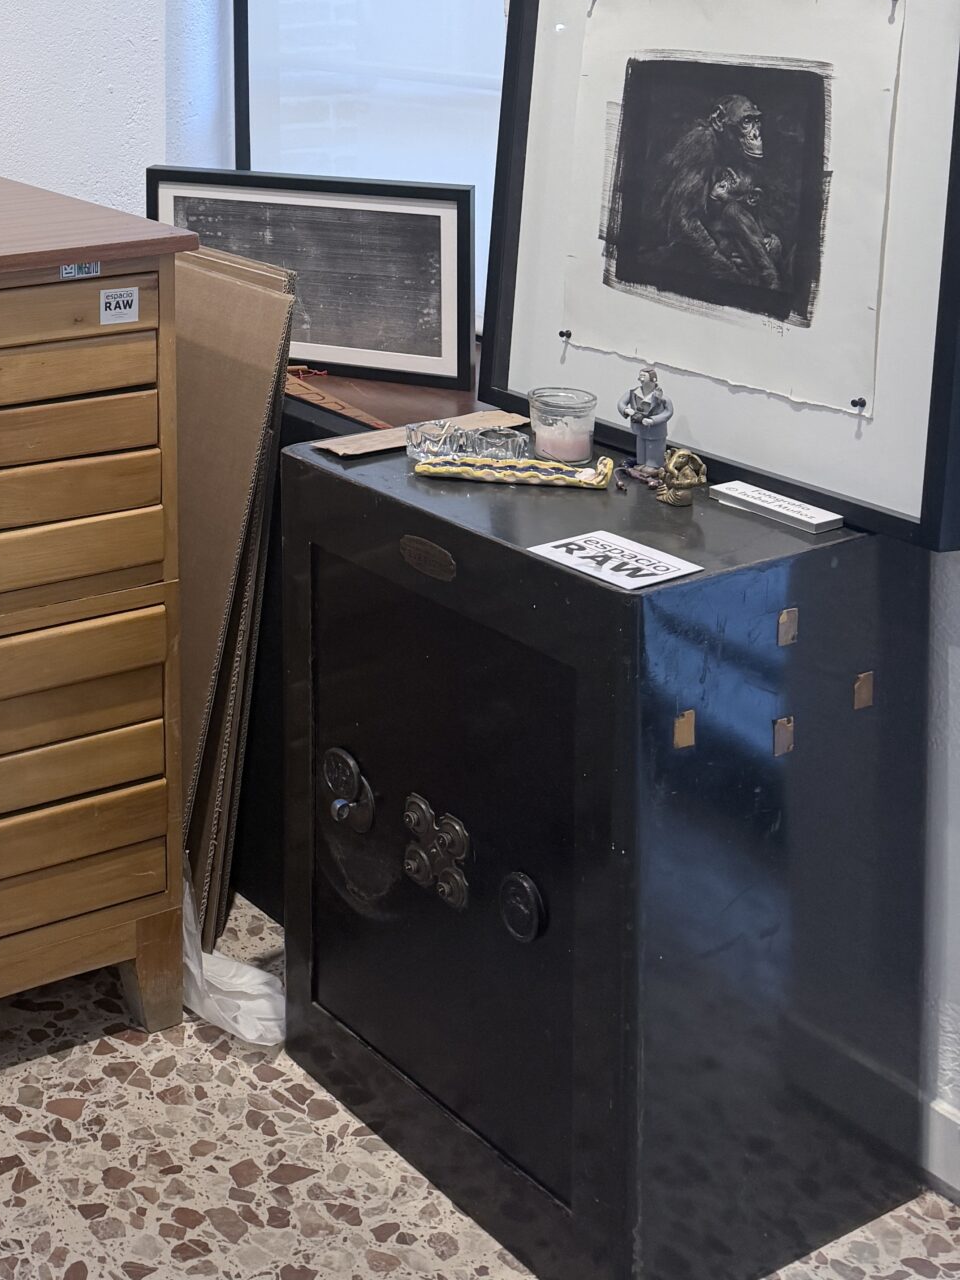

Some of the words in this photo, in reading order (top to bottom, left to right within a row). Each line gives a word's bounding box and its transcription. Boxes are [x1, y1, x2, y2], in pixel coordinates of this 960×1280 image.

[105, 299, 133, 311] RAW
[551, 542, 658, 579] RAW
[583, 539, 670, 572] espacio
